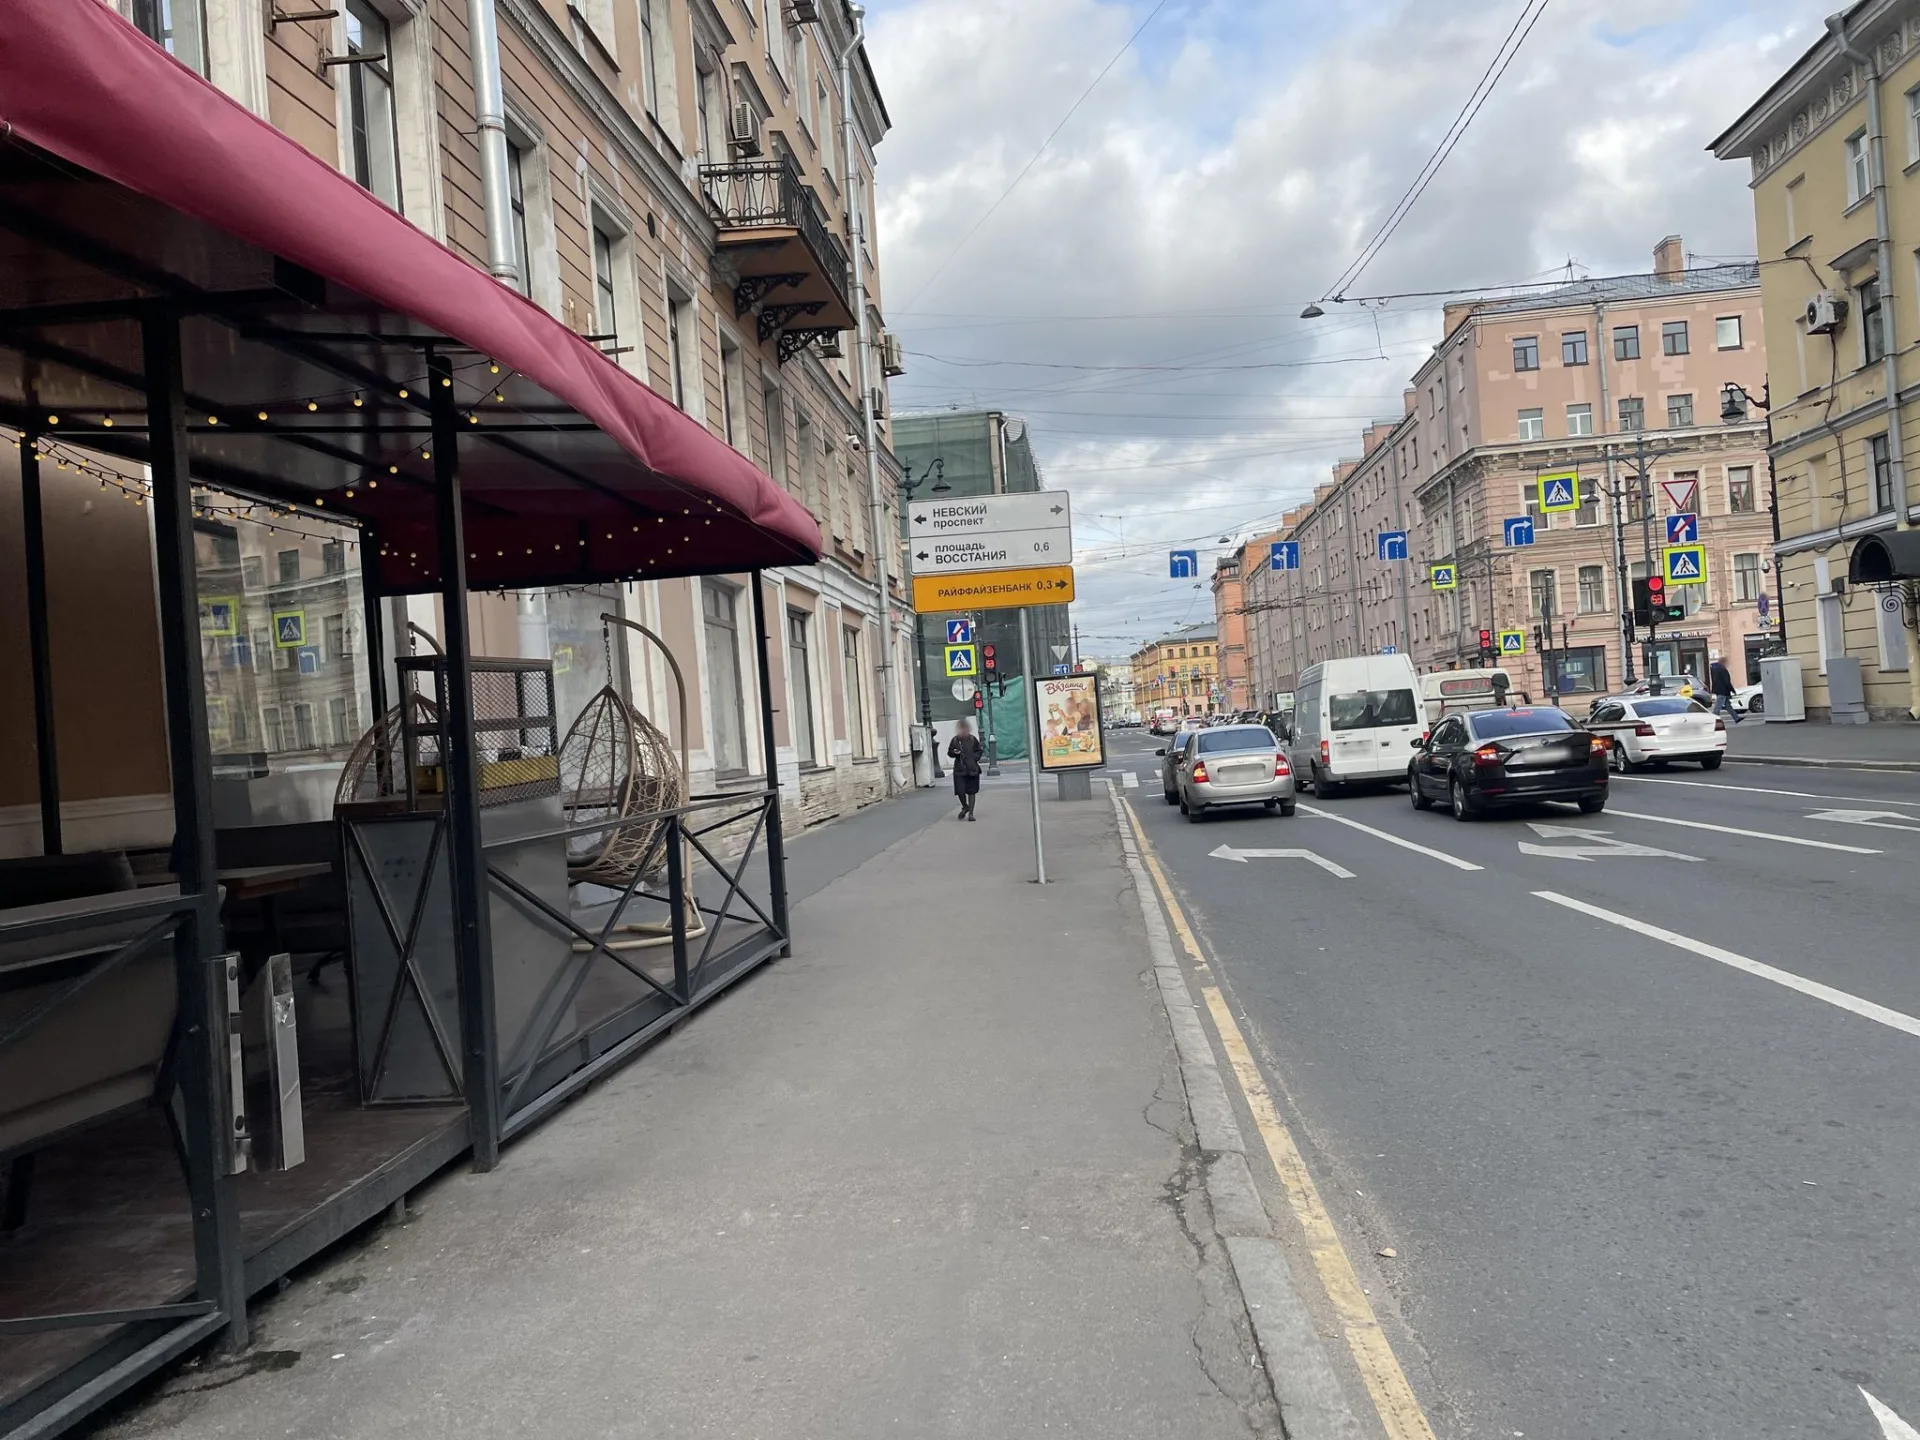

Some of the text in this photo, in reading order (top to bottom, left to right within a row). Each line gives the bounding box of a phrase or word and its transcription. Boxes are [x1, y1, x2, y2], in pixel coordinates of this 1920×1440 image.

[932, 503, 987, 518] НЕВСКИЙ
[933, 517, 985, 530] проспект
[934, 542, 986, 553] площадь
[1033, 541, 1050, 553] 0,6
[935, 550, 1007, 564] ВОССТАНИЯ
[938, 580, 1053, 597] РАЙФФАЙЗЕНБАНК 0,3
